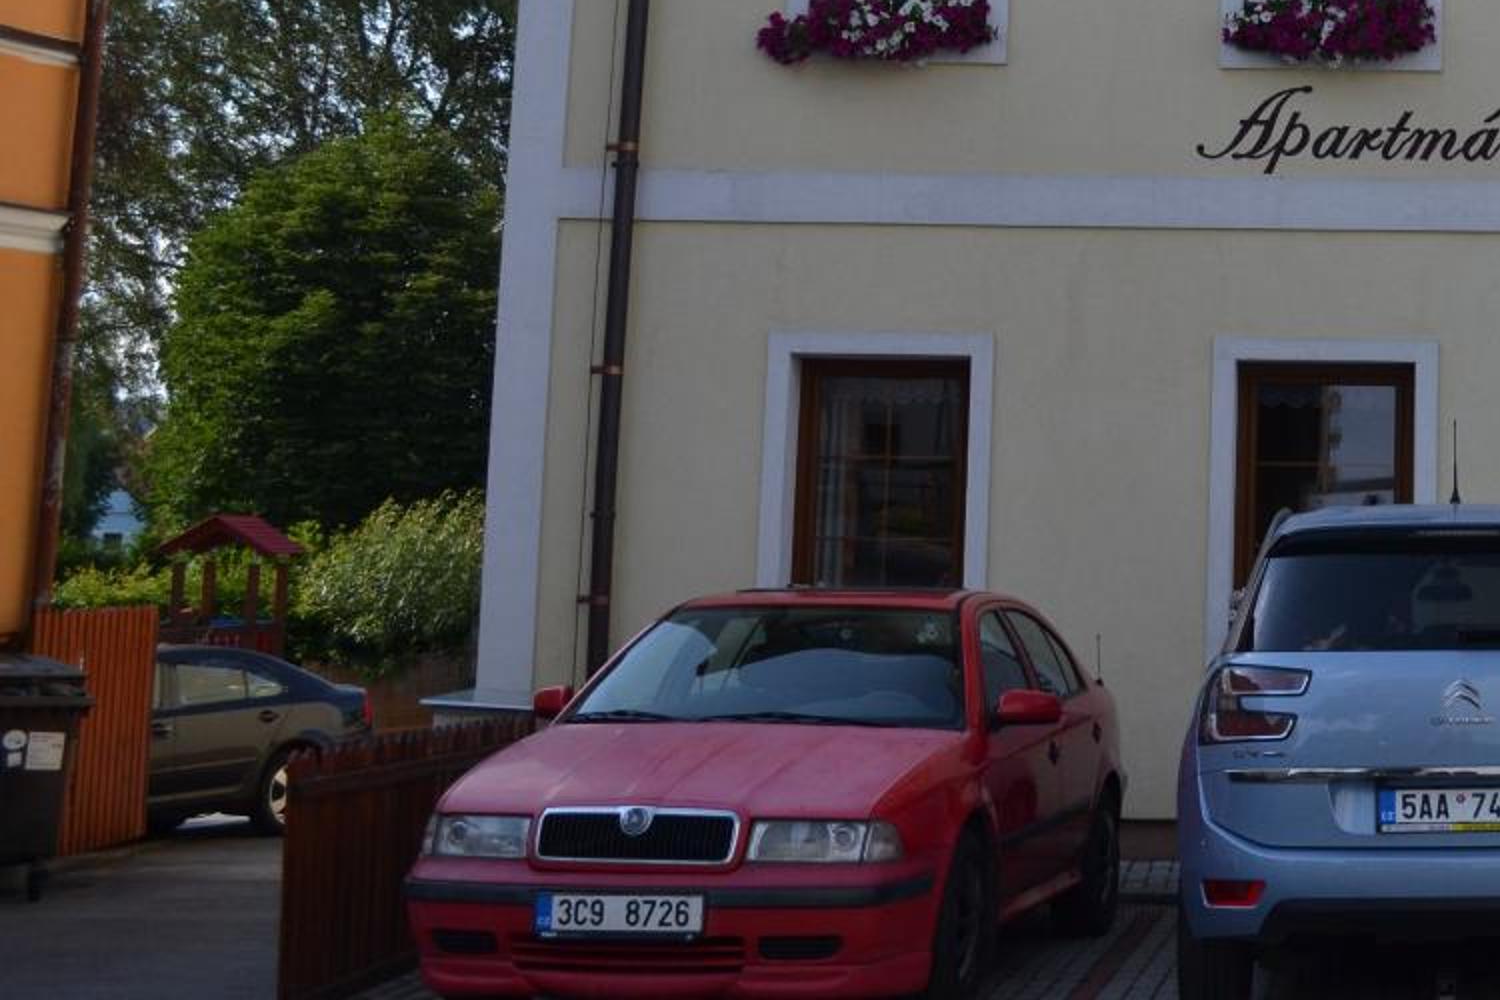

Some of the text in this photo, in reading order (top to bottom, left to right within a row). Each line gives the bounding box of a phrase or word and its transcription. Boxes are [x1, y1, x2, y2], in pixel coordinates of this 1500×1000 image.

[1401, 793, 1450, 820] 5AA
[557, 899, 690, 927] 3C9 8726
